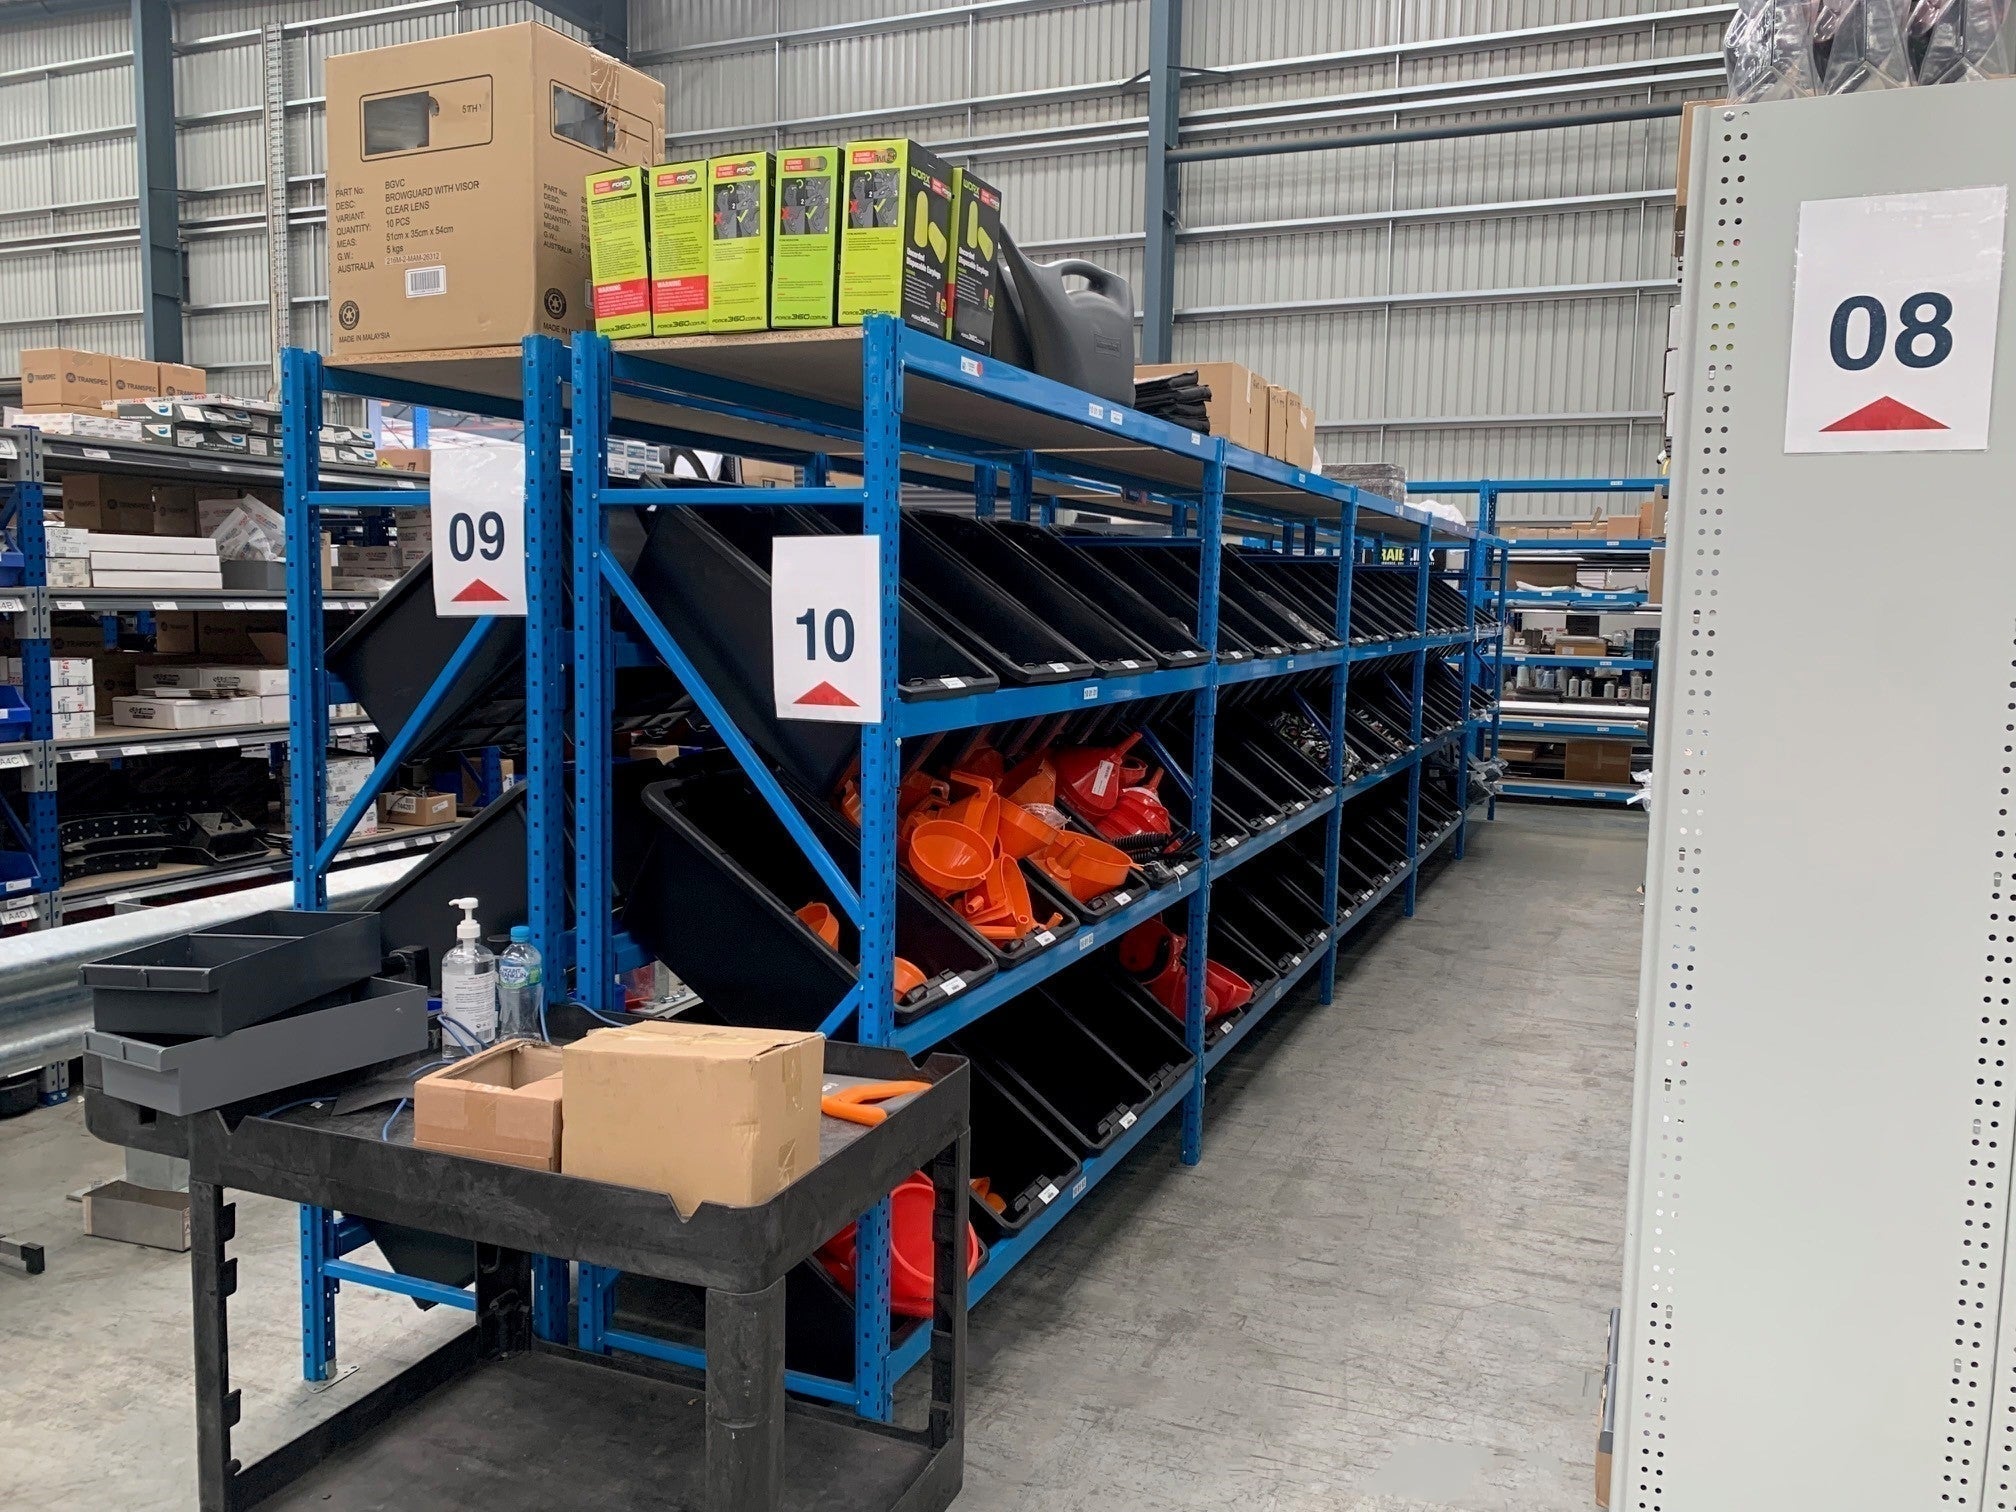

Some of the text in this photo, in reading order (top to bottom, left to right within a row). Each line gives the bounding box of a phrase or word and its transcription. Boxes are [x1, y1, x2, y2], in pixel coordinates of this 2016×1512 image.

[676, 174, 696, 182] FORCE
[911, 166, 930, 184] WORX
[385, 178, 406, 190] BGVC
[963, 178, 979, 196] WORX
[335, 186, 364, 198] PART No:
[385, 180, 480, 202] BROWGUARD WITH VISOR
[336, 200, 355, 210] DESC:
[386, 201, 430, 214] CLEAR LENS
[336, 212, 366, 222] VARIANT:
[386, 217, 410, 228] 10 PCS
[336, 224, 371, 236] QUANTITY:
[386, 232, 404, 242] 51cm
[410, 228, 428, 238] 35cm
[435, 225, 454, 236] 54cm
[336, 238, 356, 248] MEAS:
[544, 241, 572, 254] AUSTRALIA
[392, 245, 404, 254] kgs
[337, 262, 374, 274] AUSTRALIA
[544, 322, 560, 332] MADE
[1829, 292, 1953, 371] 08
[362, 332, 390, 341] MALAYSIA
[77, 376, 108, 386] TRANSPEC
[127, 383, 157, 393] TRANSPEC
[450, 511, 505, 562] 09
[795, 608, 856, 662] 10
[500, 972, 528, 980] RANKLIN
